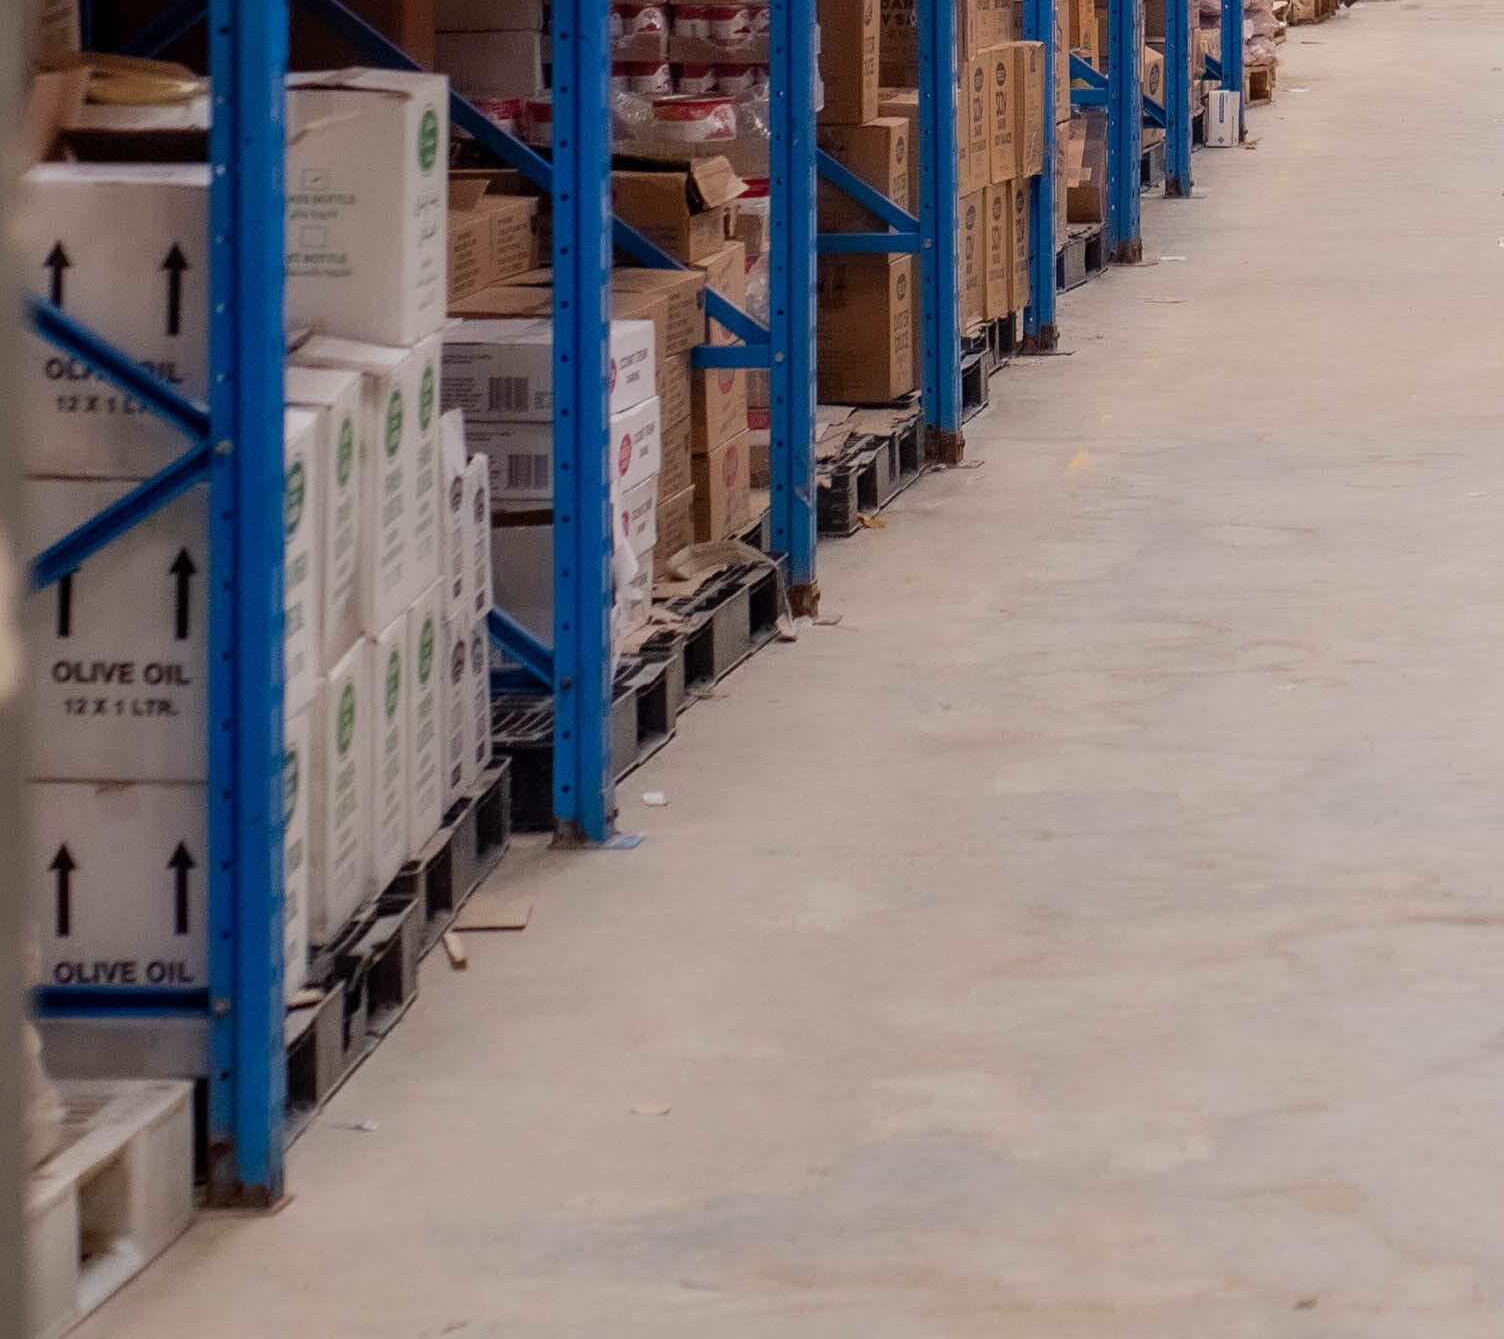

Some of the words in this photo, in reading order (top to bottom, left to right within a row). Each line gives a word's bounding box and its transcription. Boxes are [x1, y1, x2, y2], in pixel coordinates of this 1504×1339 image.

[53, 659, 136, 684] OLIVE
[143, 661, 192, 686] OIL
[64, 697, 87, 716] 12
[93, 697, 107, 716] X
[53, 960, 137, 984] OLIVE
[145, 960, 195, 984] OIL
